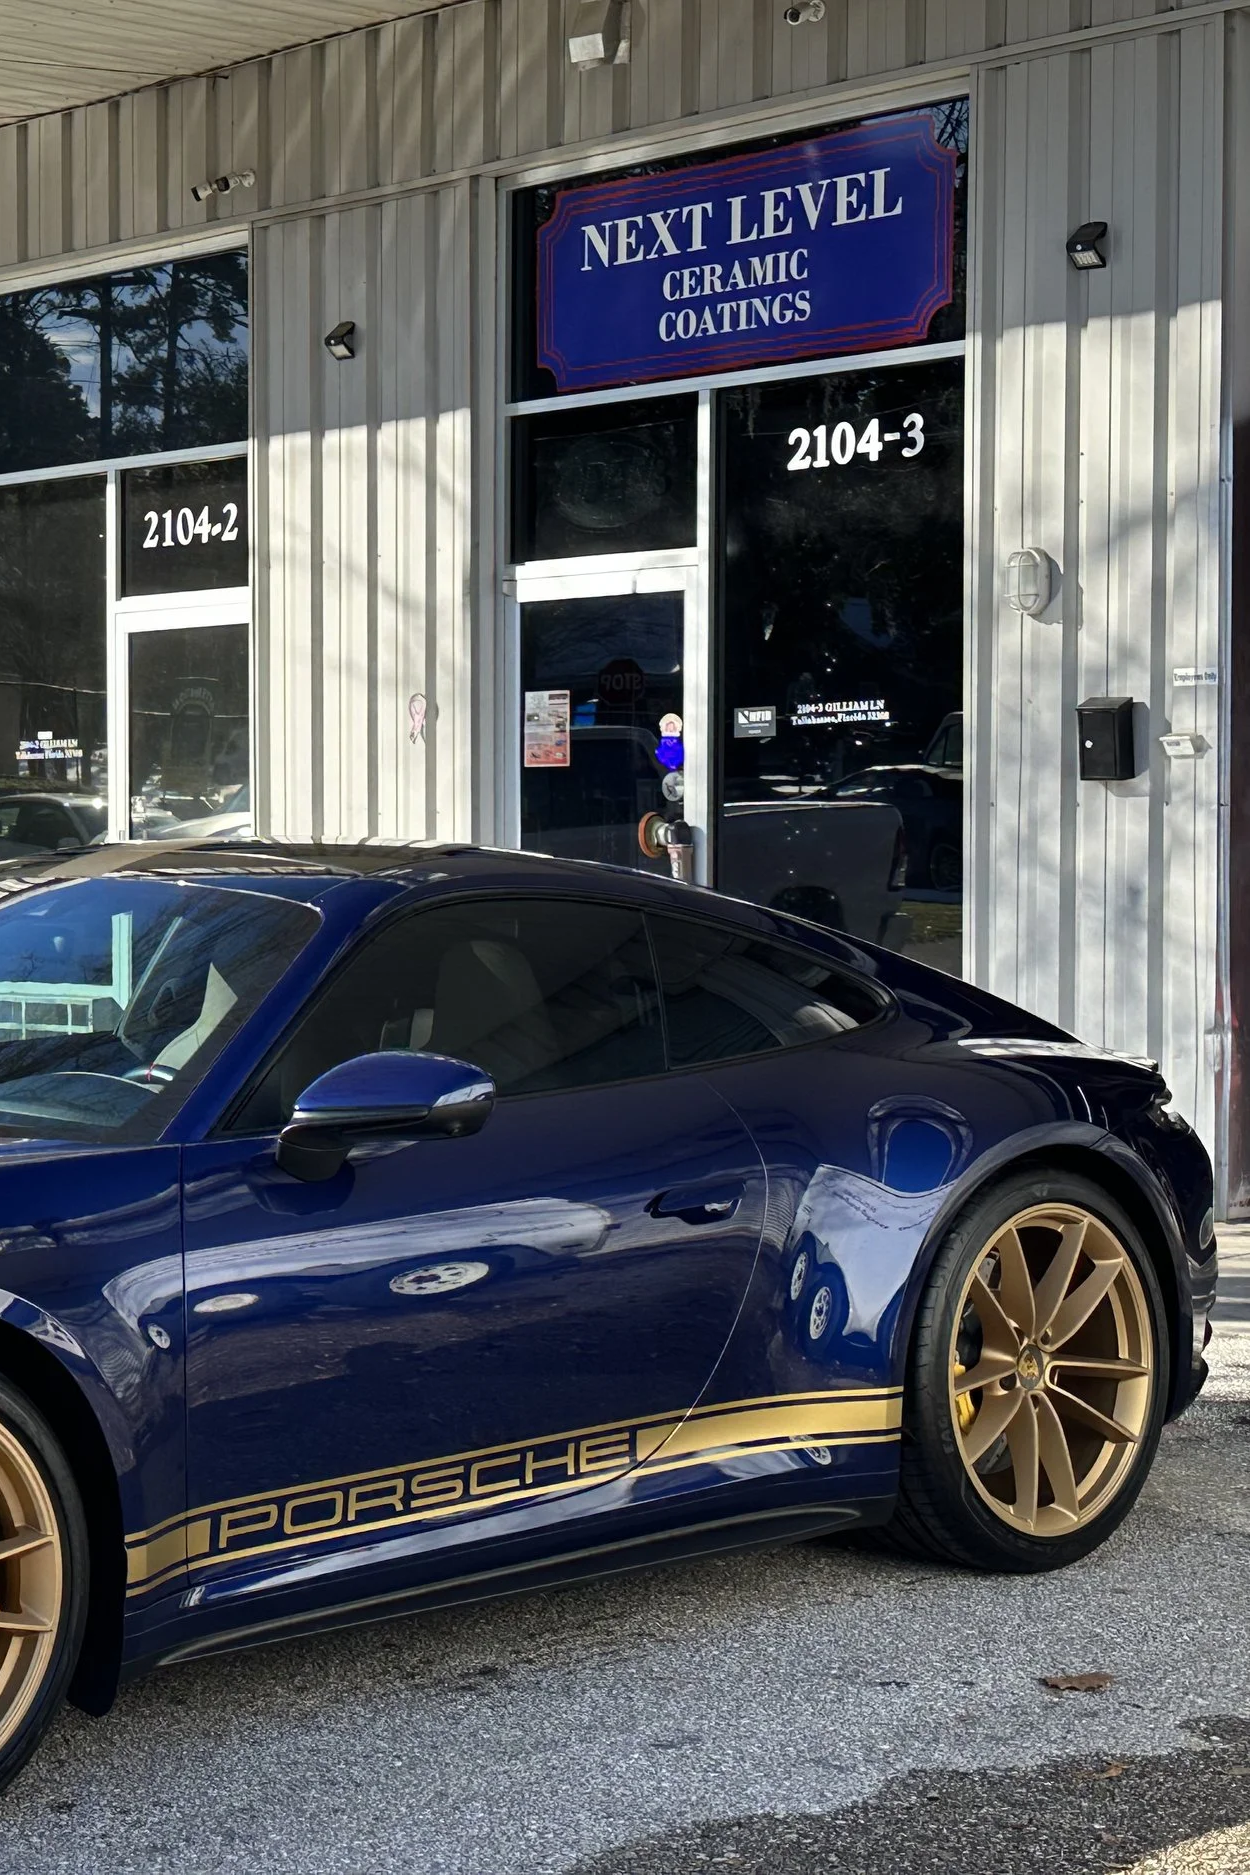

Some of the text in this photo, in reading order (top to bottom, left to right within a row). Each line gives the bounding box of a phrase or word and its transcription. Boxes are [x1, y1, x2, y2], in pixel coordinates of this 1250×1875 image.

[580, 167, 903, 272] NEXT LEVEL
[662, 248, 809, 302] CERAMIC
[658, 289, 812, 342] COATINGS
[786, 412, 925, 472] 2104-3
[142, 502, 239, 549] 2104-2
[218, 1431, 631, 1549] PORSCHE
